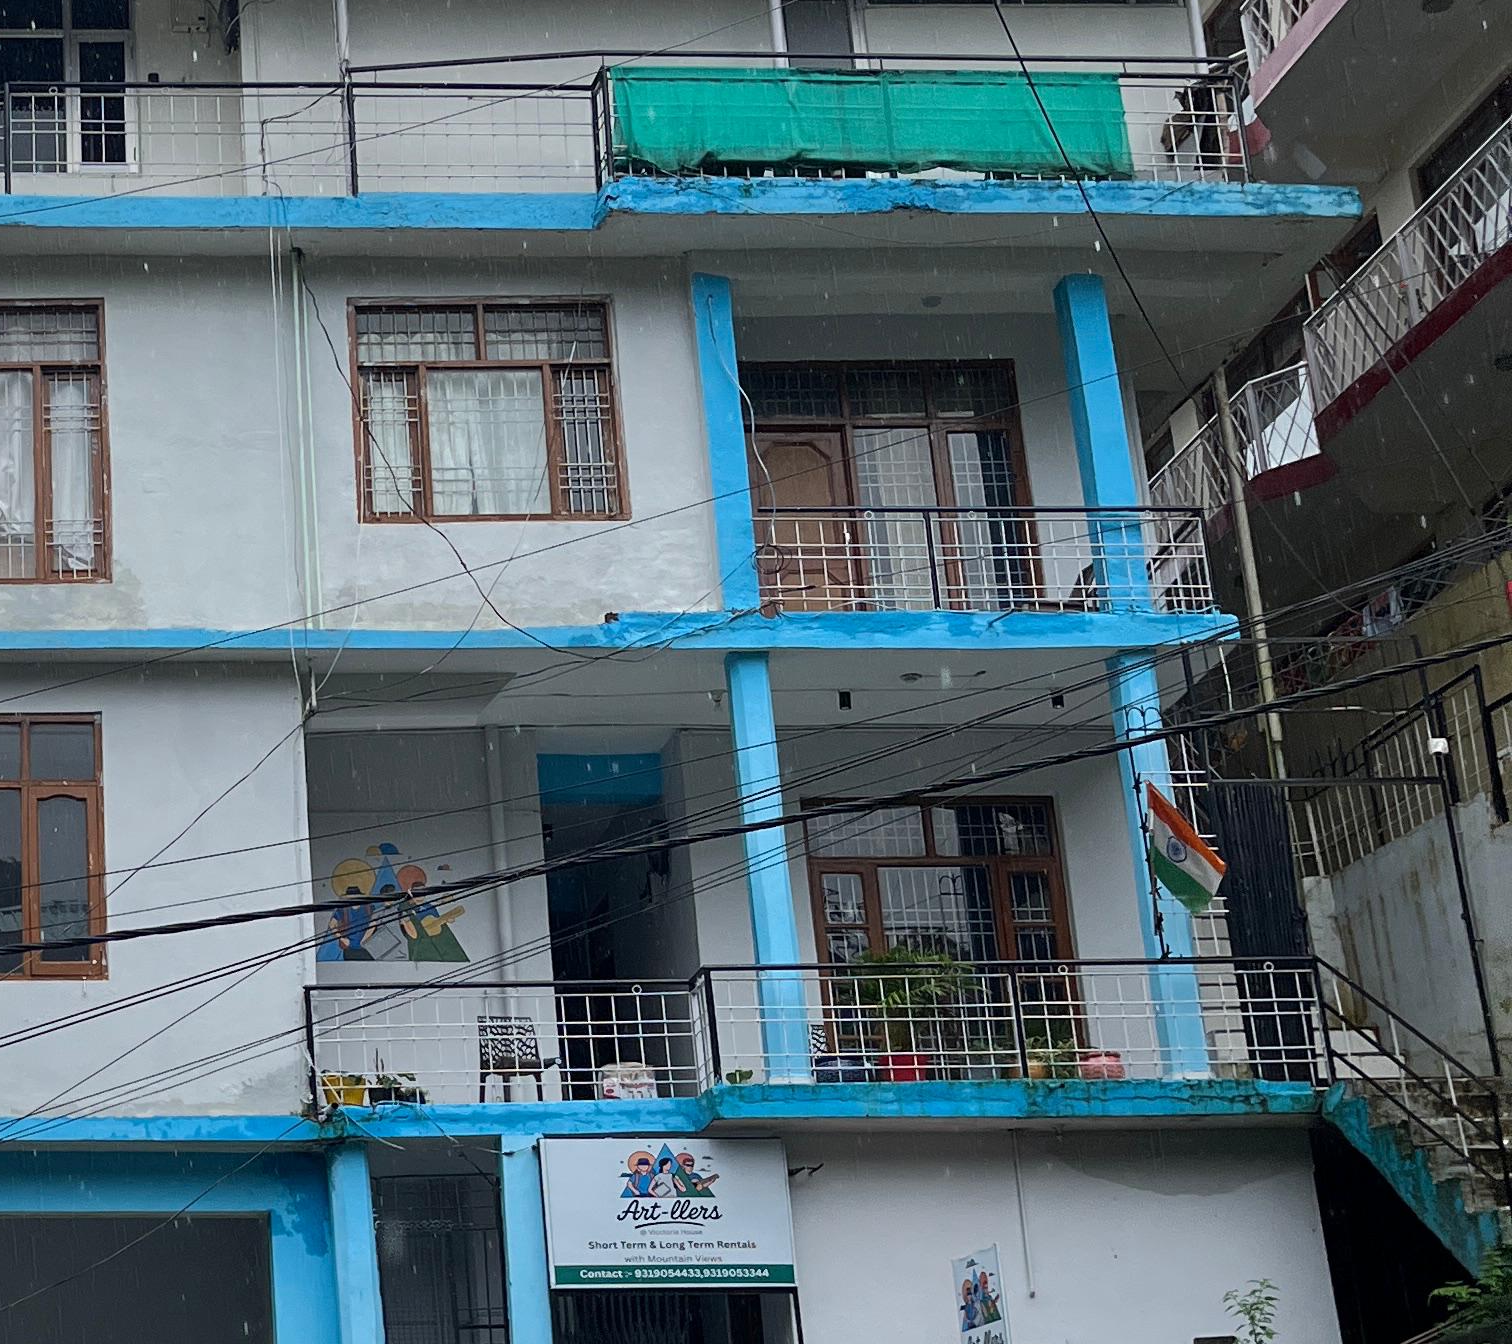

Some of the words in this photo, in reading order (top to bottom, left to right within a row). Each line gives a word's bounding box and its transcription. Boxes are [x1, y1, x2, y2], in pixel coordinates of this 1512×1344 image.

[617, 1199, 723, 1221] Art-llers
[588, 1240, 618, 1250] Short
[620, 1240, 647, 1250] Term
[649, 1240, 657, 1249] &
[659, 1240, 686, 1251] Long
[688, 1240, 715, 1249] Term
[717, 1240, 757, 1249] Rentals
[624, 1255, 645, 1263] with
[647, 1255, 693, 1263] Mountain
[695, 1255, 723, 1263] Views
[579, 1269, 623, 1279] Contact
